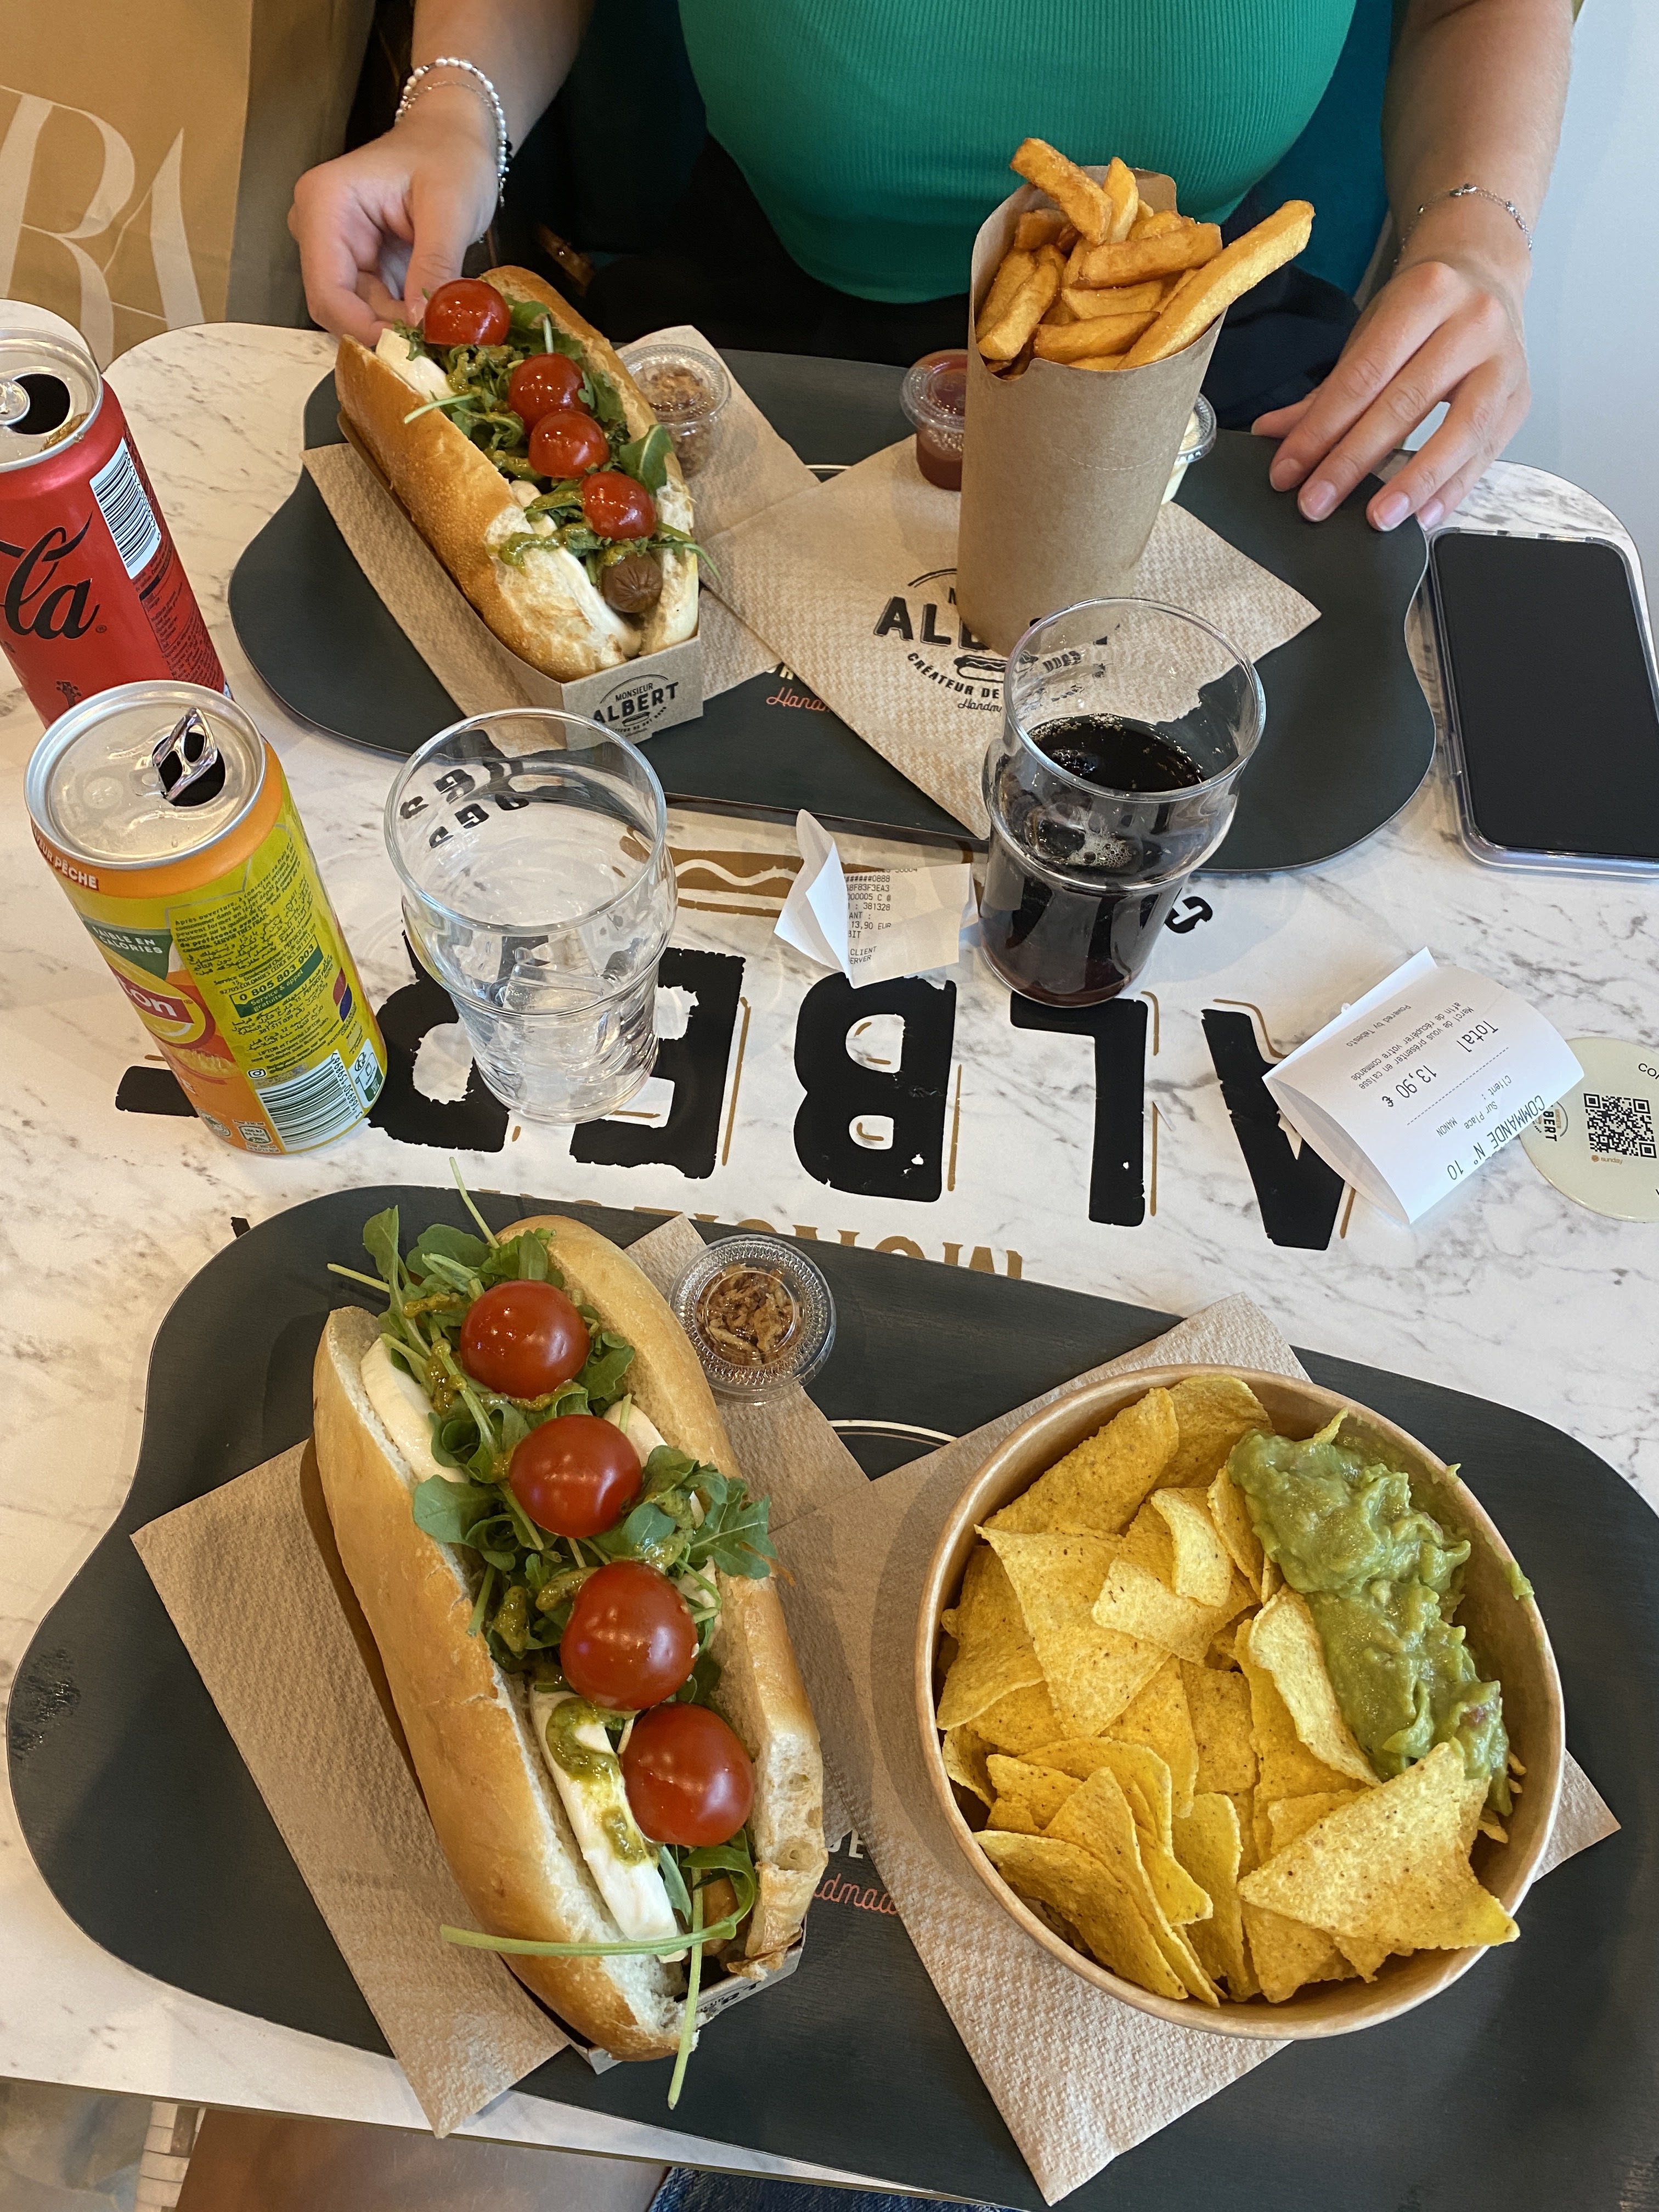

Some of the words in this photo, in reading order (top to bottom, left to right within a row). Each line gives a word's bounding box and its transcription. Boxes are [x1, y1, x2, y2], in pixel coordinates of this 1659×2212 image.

[907, 653, 973, 695] CRÉATEUR
[981, 688, 1000, 699] DE
[616, 682, 653, 702] MONSIEUR
[594, 681, 679, 724] ALBERT
[54, 857, 98, 889] PÊCHE
[849, 911, 863, 919] ANT
[863, 902, 891, 911] 381328
[851, 921, 873, 930] 13,90
[99, 936, 163, 955] CALORIES
[135, 937, 156, 946] EN
[850, 945, 877, 956] CLIENT
[850, 955, 872, 964] ERVER
[251, 980, 274, 996] 805
[276, 964, 296, 983] 803
[298, 943, 315, 964] 903
[250, 989, 278, 1006] Service
[286, 969, 303, 986] appel
[253, 994, 283, 1012] gratuits
[1446, 1002, 1461, 1014] afin
[1383, 1005, 1411, 1023] Powered
[1452, 1006, 1474, 1022] Merci
[1346, 1029, 1375, 1047] Tabesto
[1403, 1020, 1435, 1045] récupérer
[1426, 1028, 1443, 1040] vous
[1456, 1020, 1498, 1052] Total
[1381, 1044, 1402, 1059] votre
[1395, 1037, 1426, 1064] présenter
[332, 1057, 348, 1085] 159896
[1351, 1058, 1382, 1081] commande
[1382, 1064, 1393, 1072] en
[1358, 1071, 1383, 1090] caisse
[1396, 1065, 1436, 1098] 13,90
[1487, 1075, 1512, 1096] Client
[343, 1085, 359, 1111] 168930
[1381, 1096, 1394, 1107] €
[1486, 1101, 1498, 1114] Sur
[1436, 1117, 1457, 1137] MANON
[1464, 1111, 1485, 1129] Place
[1487, 1096, 1545, 1148] COMMANDE
[1473, 1142, 1486, 1165] N°
[1600, 1156, 1623, 1165] sunday
[1447, 1160, 1464, 1180] 10
